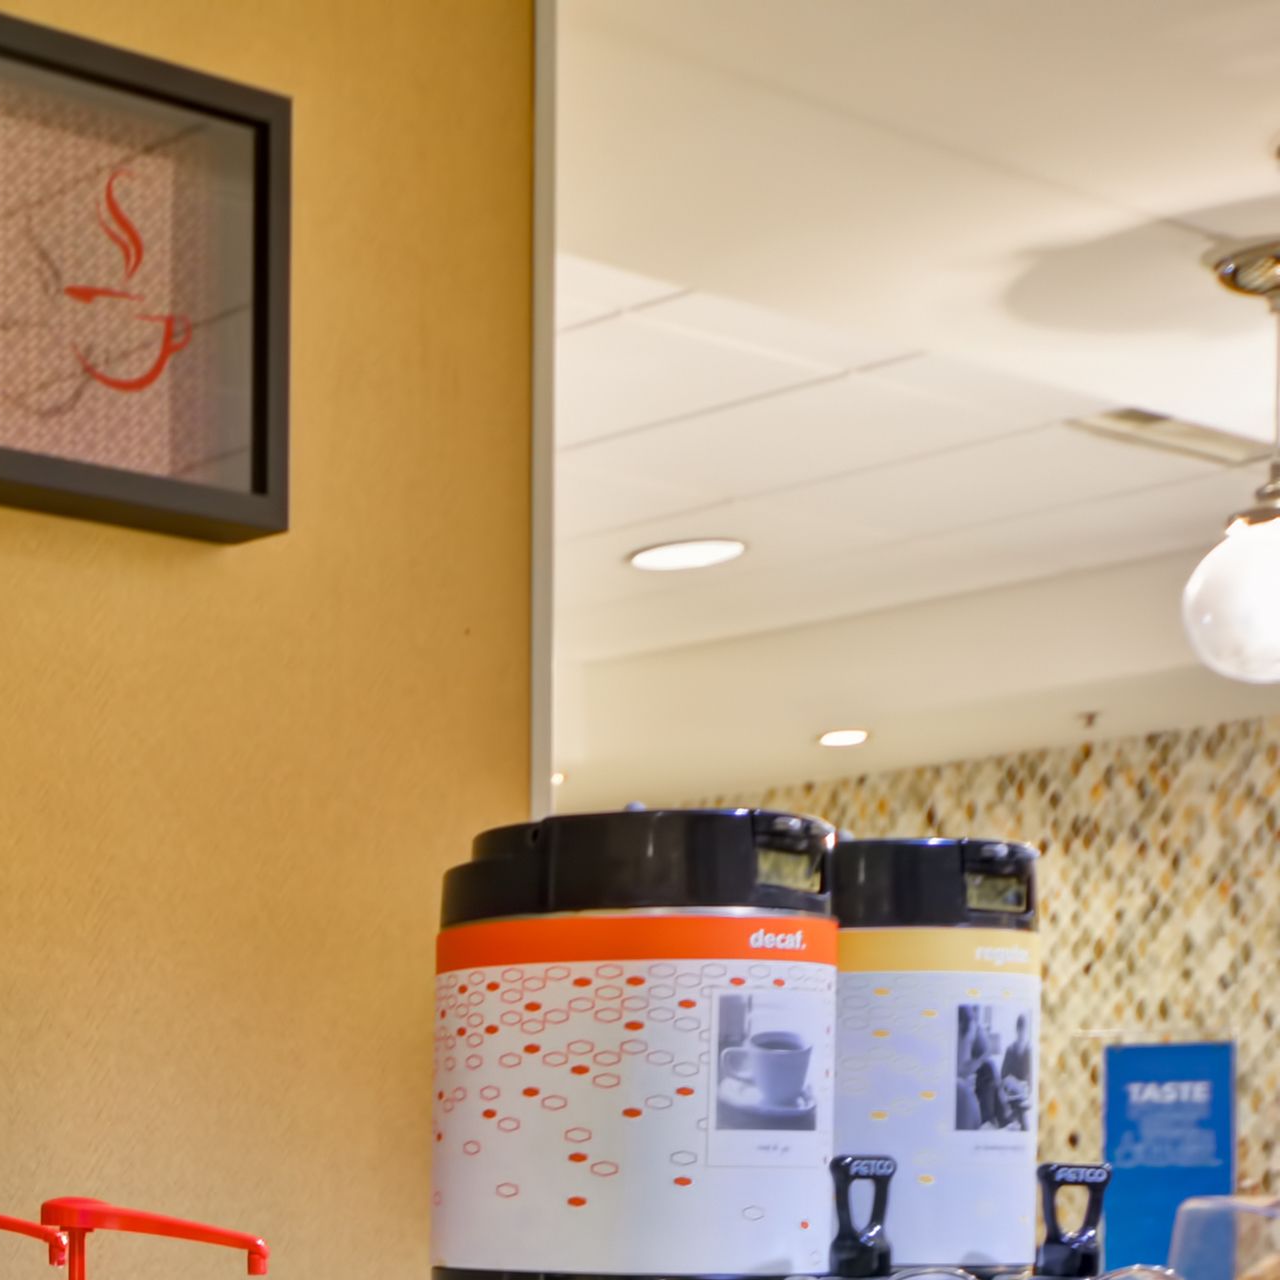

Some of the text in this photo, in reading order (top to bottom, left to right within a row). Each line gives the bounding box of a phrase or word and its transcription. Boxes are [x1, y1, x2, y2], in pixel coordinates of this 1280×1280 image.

[1126, 1081, 1209, 1103] TASTE
[850, 1160, 893, 1177] FETCO
[1055, 1167, 1107, 1183] FETCO
